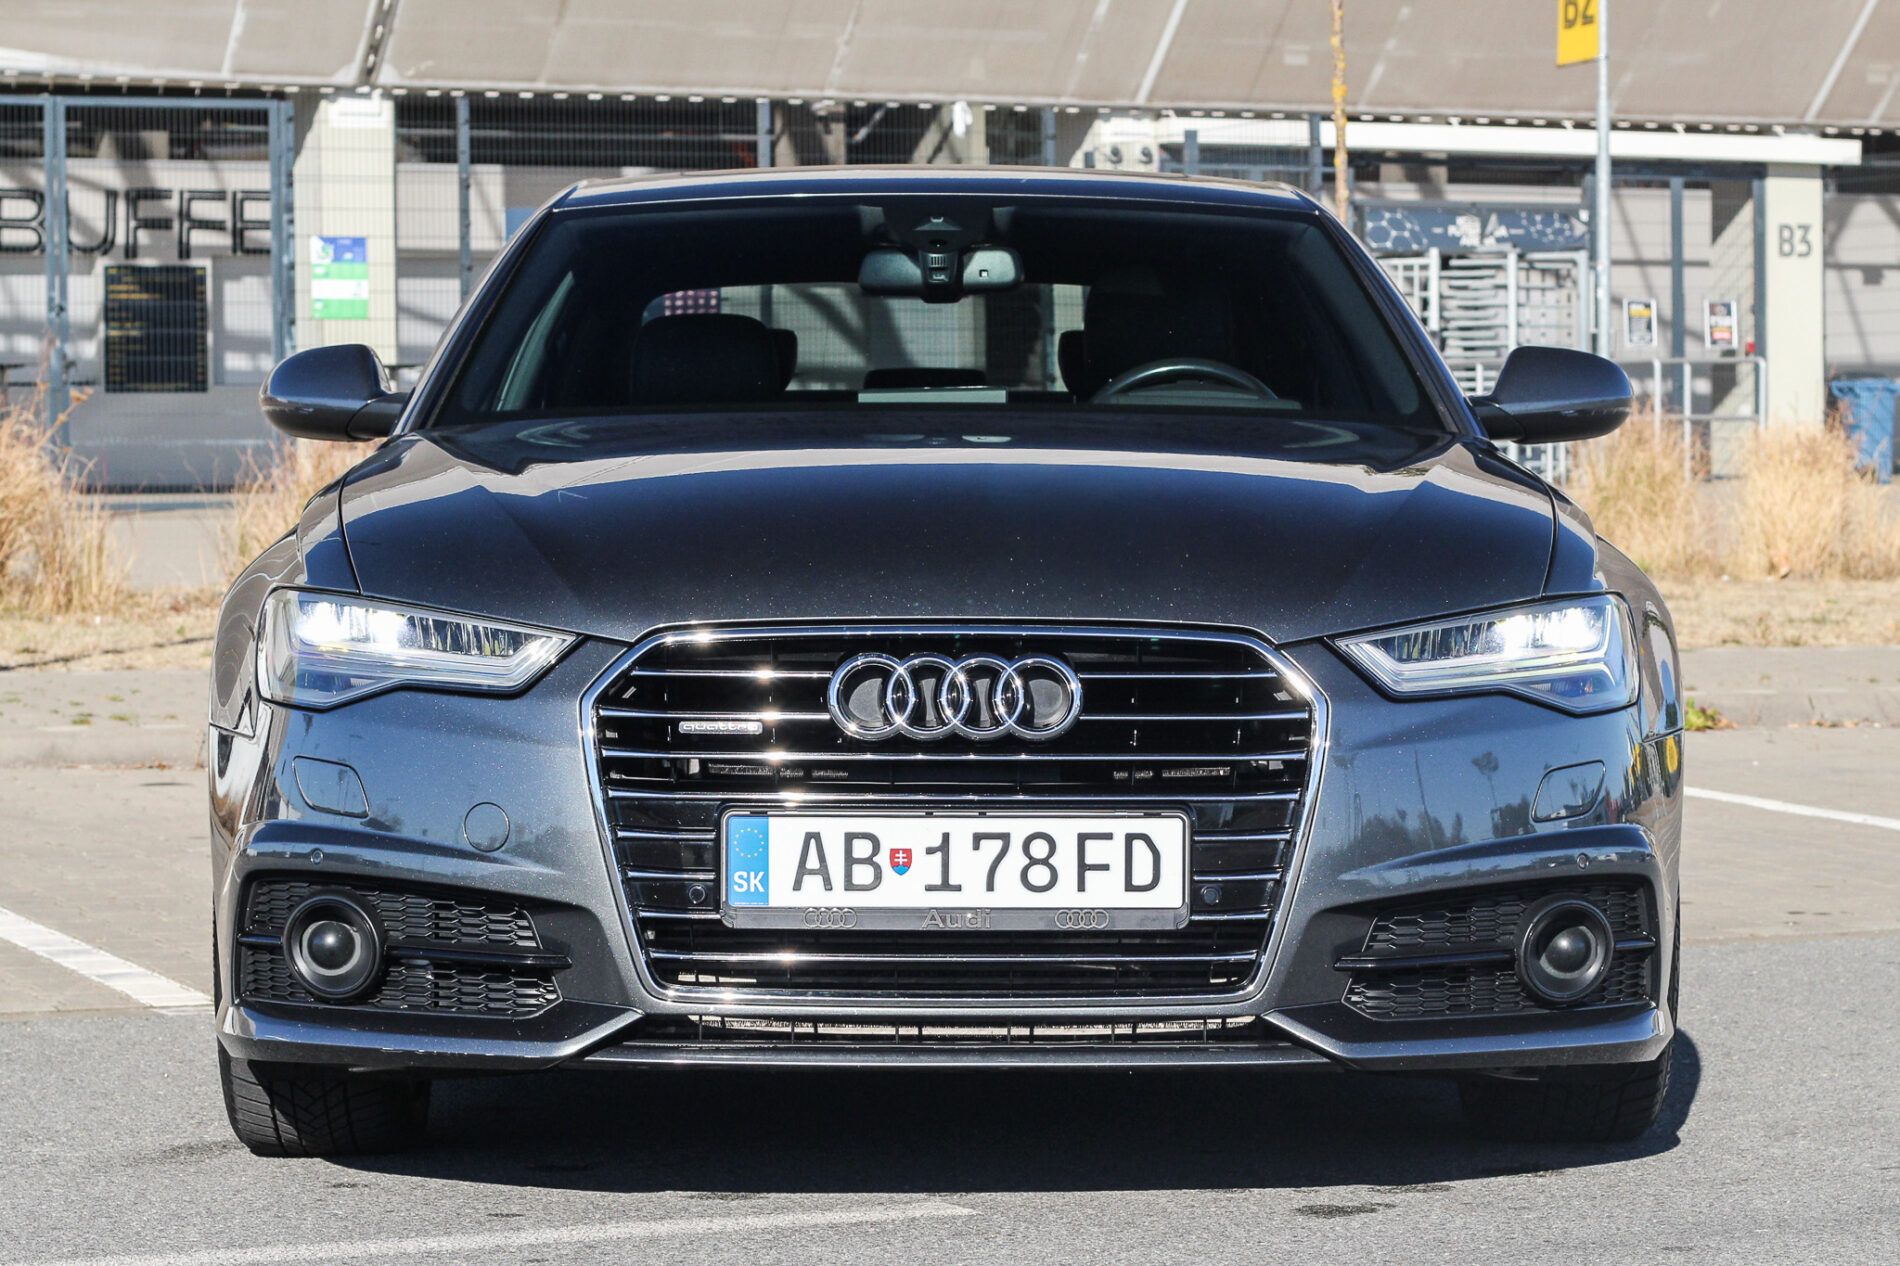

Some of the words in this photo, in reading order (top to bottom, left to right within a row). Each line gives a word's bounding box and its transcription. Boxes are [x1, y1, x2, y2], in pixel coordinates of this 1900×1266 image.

[1779, 224, 1812, 257] B3
[733, 871, 765, 893] SK
[921, 908, 991, 929] Audi
